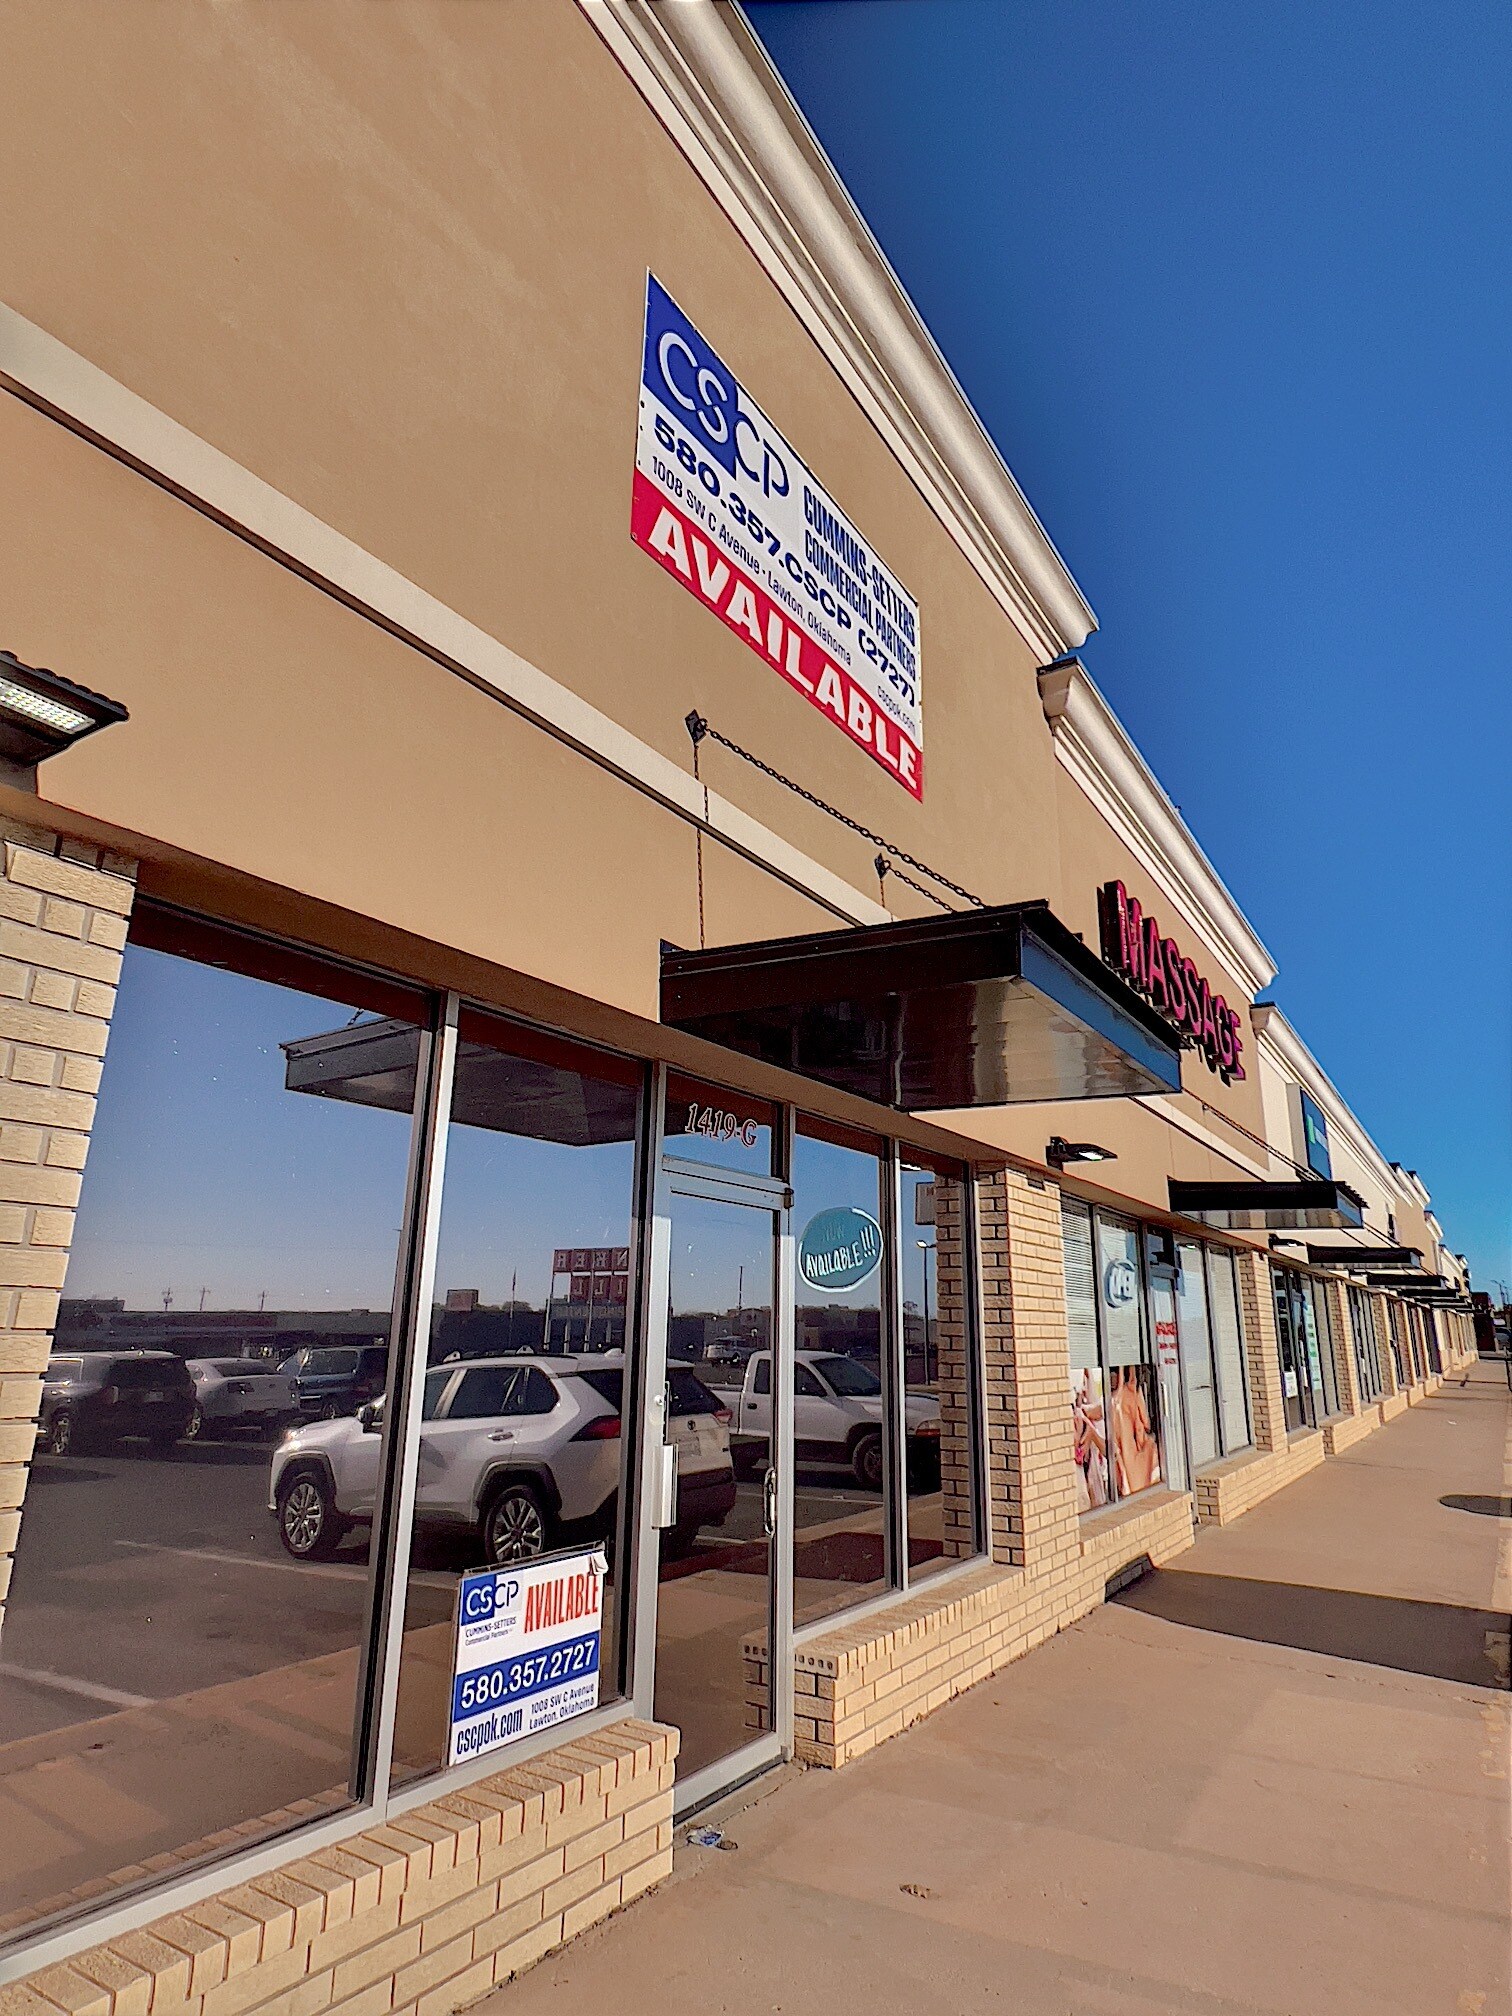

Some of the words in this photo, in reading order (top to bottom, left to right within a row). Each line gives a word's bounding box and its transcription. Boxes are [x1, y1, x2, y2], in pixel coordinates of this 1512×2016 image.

[659, 331, 790, 498] CSCP
[652, 455, 684, 498] 1008
[686, 489, 706, 520] SW
[708, 512, 718, 532] C
[719, 523, 760, 574] Avenue
[807, 611, 851, 666] Oklahoma
[653, 413, 852, 630] 580.357.CSCP
[858, 628, 916, 708] (2727)
[803, 485, 916, 647] CUMMINS-SETTERS
[805, 529, 874, 630] COMMERCIAL
[875, 607, 916, 682] PARTNERS
[647, 505, 918, 790] AVAILABLE
[877, 684, 917, 737] cscpok.com
[1100, 880, 1246, 1081] MASSAGE
[685, 1102, 758, 1148] 1419-G
[465, 1580, 520, 1617] CSCP
[523, 1571, 599, 1634] AVAILABLE
[461, 1639, 596, 1710] 580.357.2727
[531, 1698, 549, 1715] 1008
[550, 1693, 562, 1708] SW
[563, 1691, 568, 1703] C
[569, 1683, 595, 1700] Avenue
[559, 1696, 595, 1718] Oklahoma
[456, 1708, 523, 1755] cscpok.com
